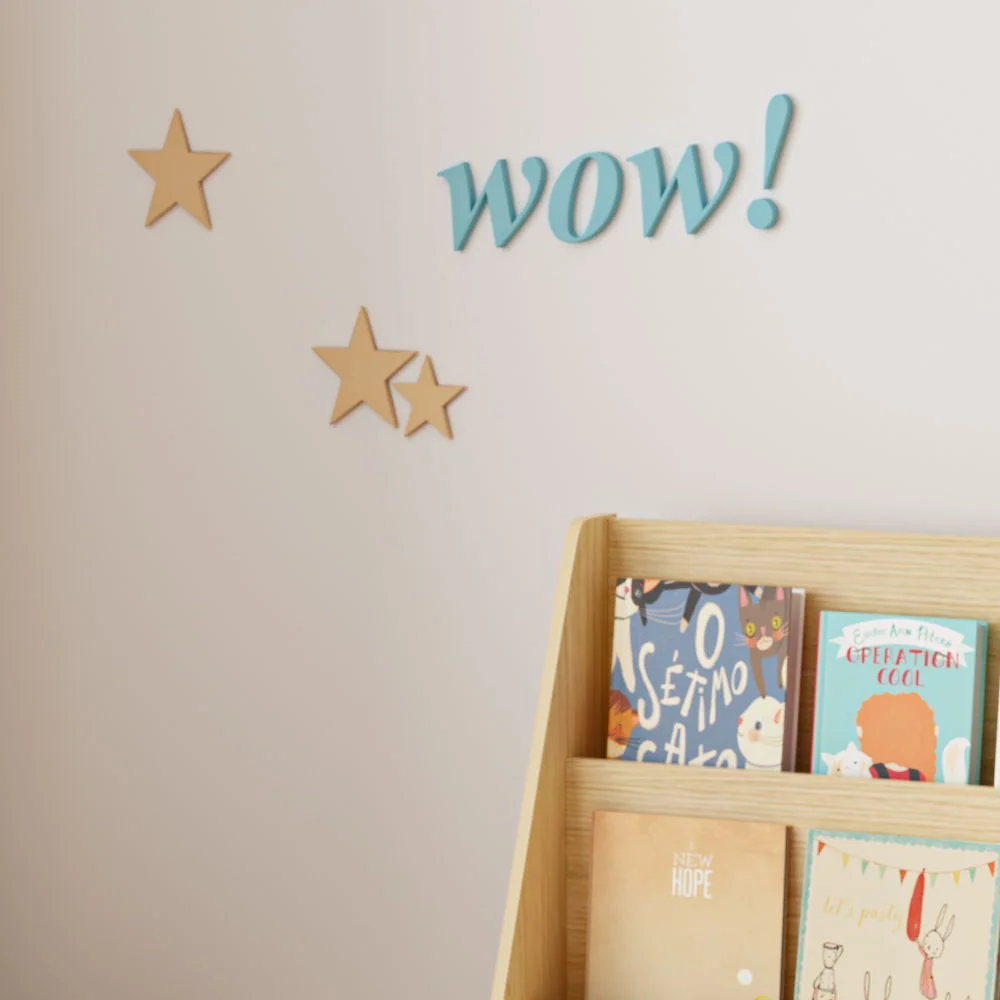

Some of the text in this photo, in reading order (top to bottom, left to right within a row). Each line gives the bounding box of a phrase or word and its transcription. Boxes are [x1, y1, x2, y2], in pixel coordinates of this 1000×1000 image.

[437, 93, 794, 251] wow!
[694, 601, 725, 669] O
[846, 645, 960, 670] OPERATION
[877, 668, 925, 687] COOL
[671, 852, 714, 868] NEW
[671, 867, 714, 899] HOPE
